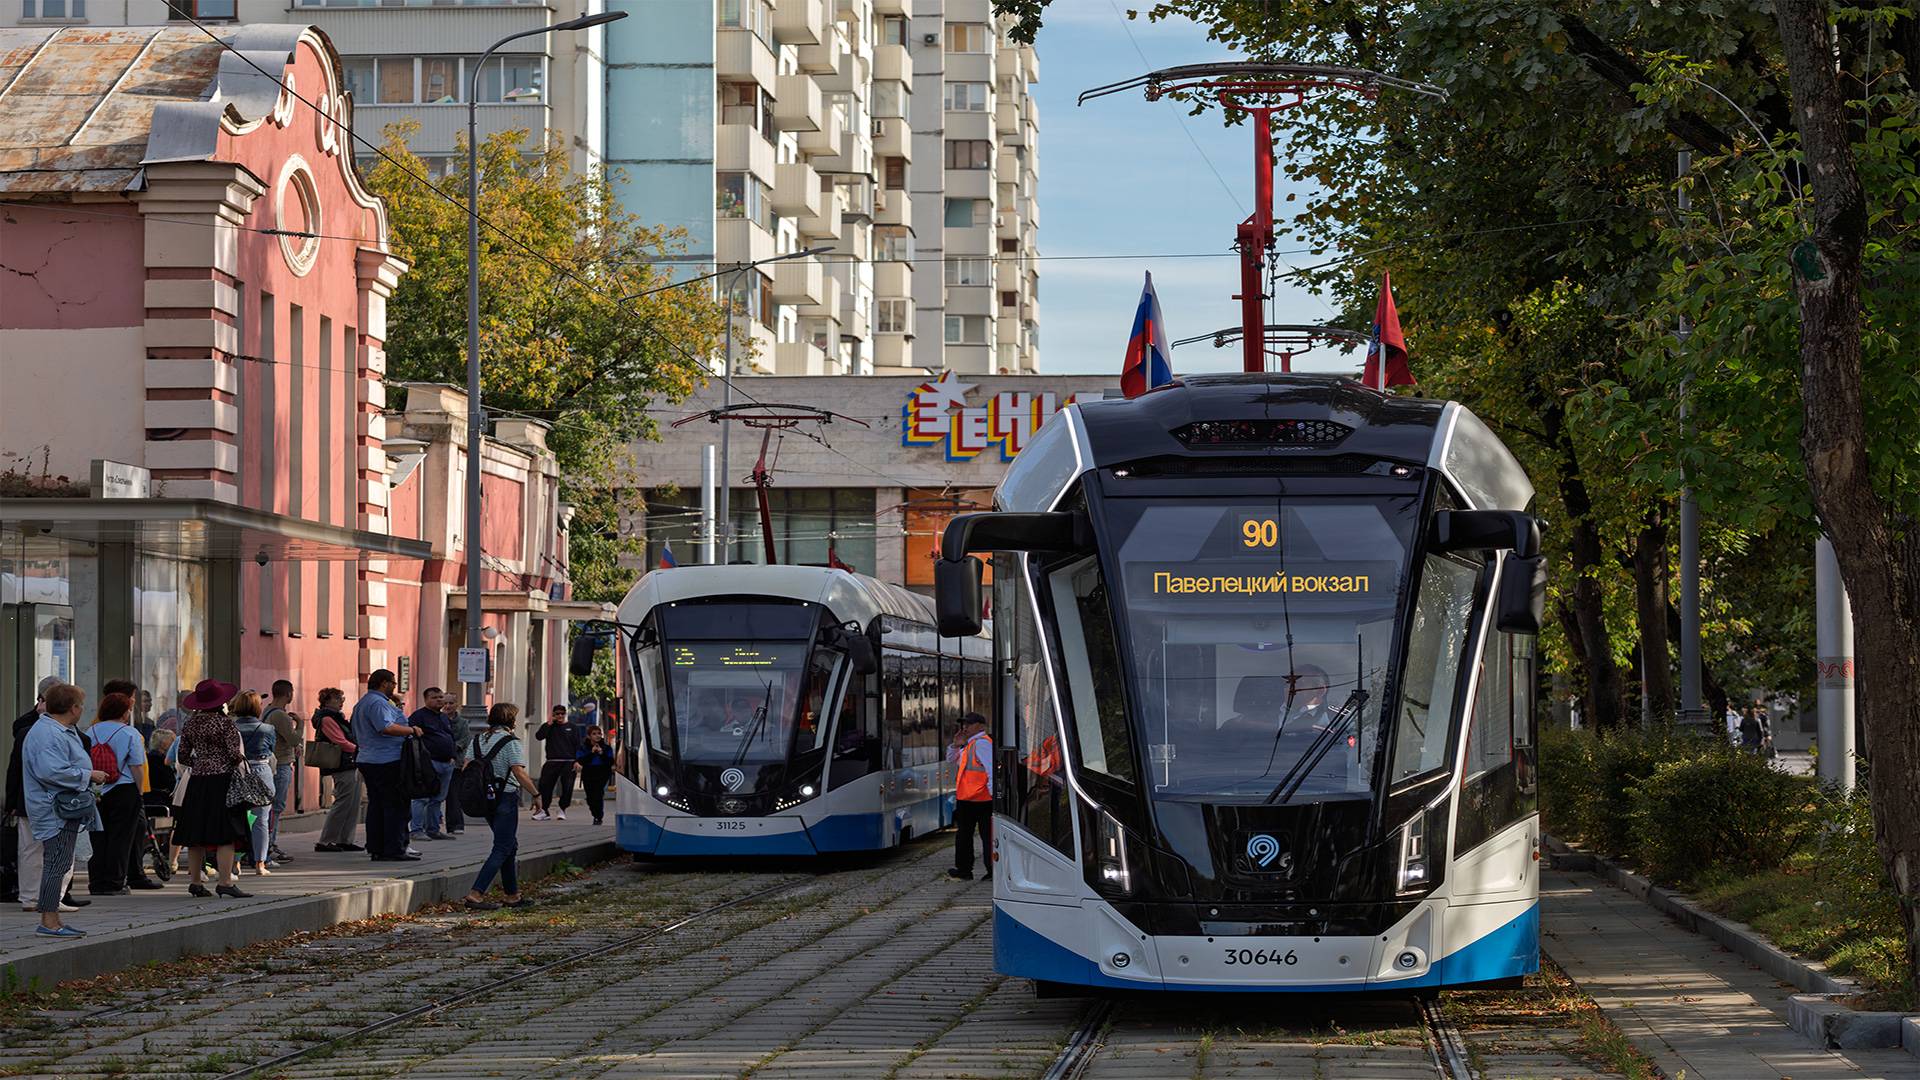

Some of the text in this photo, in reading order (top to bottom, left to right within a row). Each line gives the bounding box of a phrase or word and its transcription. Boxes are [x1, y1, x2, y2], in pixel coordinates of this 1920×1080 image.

[902, 388, 1104, 463] ЗЕН
[1242, 519, 1278, 548] 90
[1153, 570, 1369, 596] Павелецкий вокзал
[716, 821, 746, 831] 31125
[1223, 948, 1298, 966] 30646
